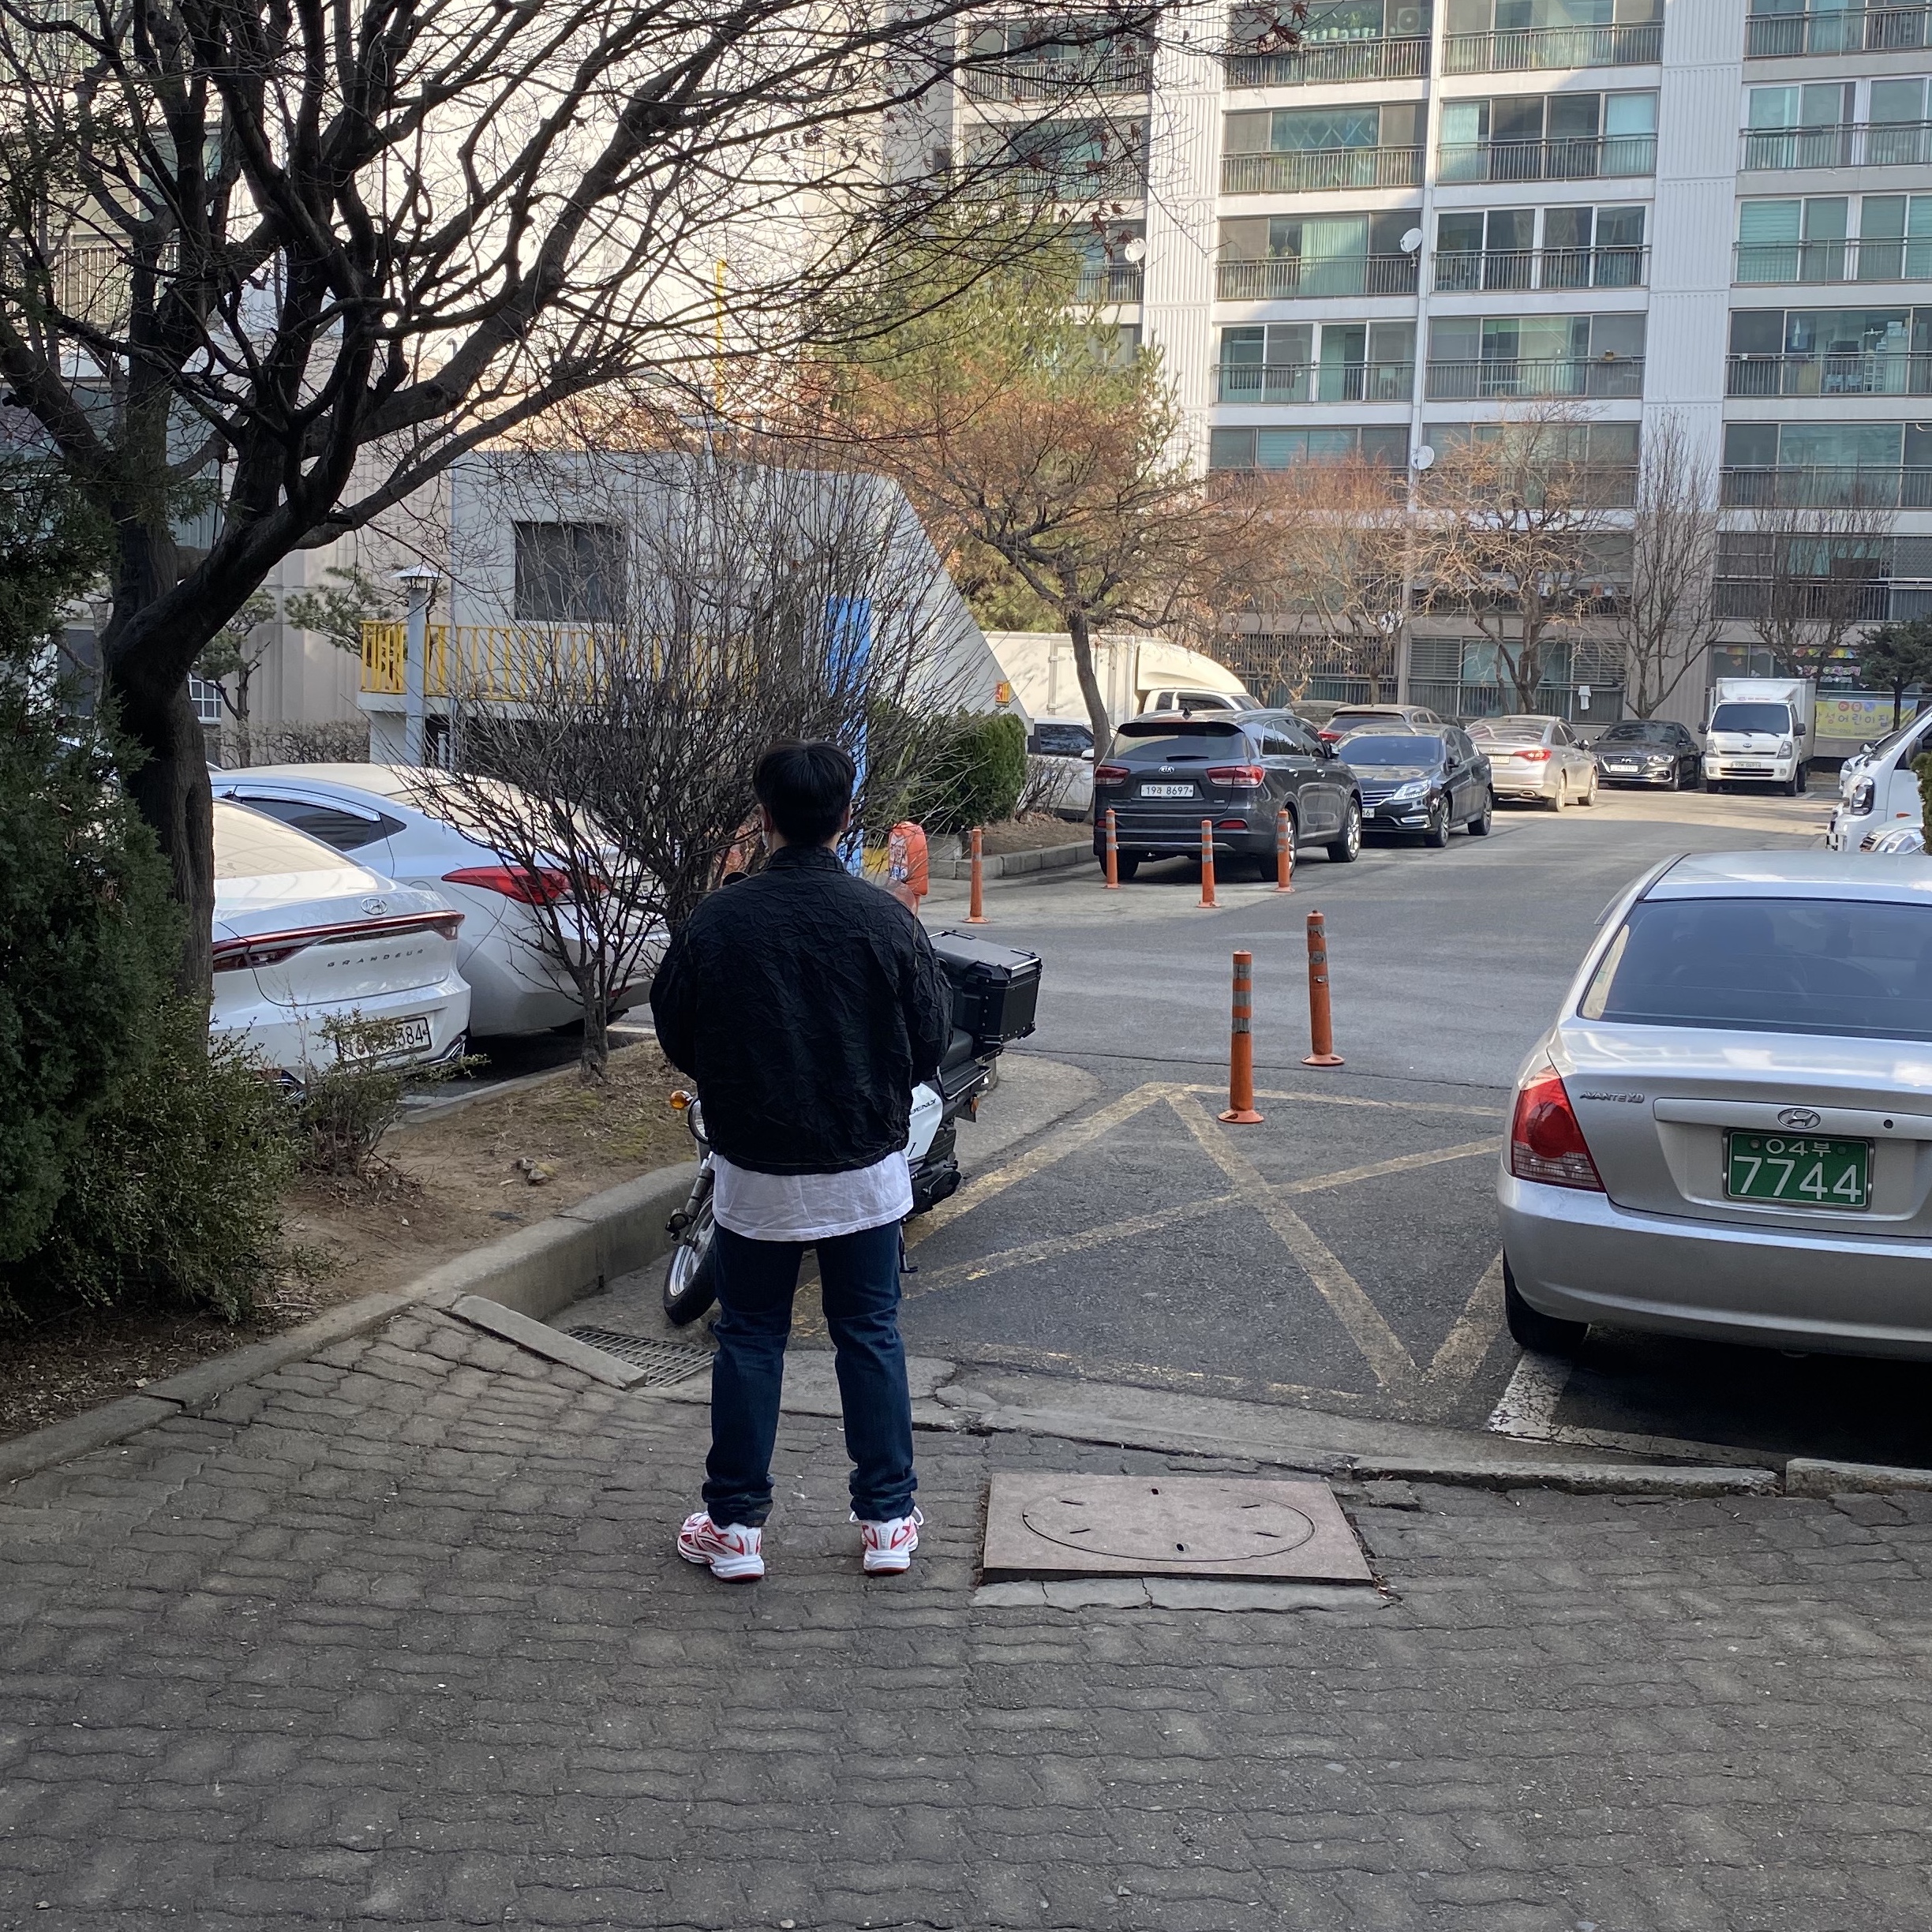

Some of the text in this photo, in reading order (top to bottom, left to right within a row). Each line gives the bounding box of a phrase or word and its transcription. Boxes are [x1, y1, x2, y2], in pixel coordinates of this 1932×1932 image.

[1166, 786, 1189, 795] 8697
[328, 949, 424, 967] GRANDEUR
[1580, 1091, 1645, 1103] AVANTE XD
[1765, 1139, 1831, 1157] 04부
[1734, 1155, 1862, 1202] 7744
